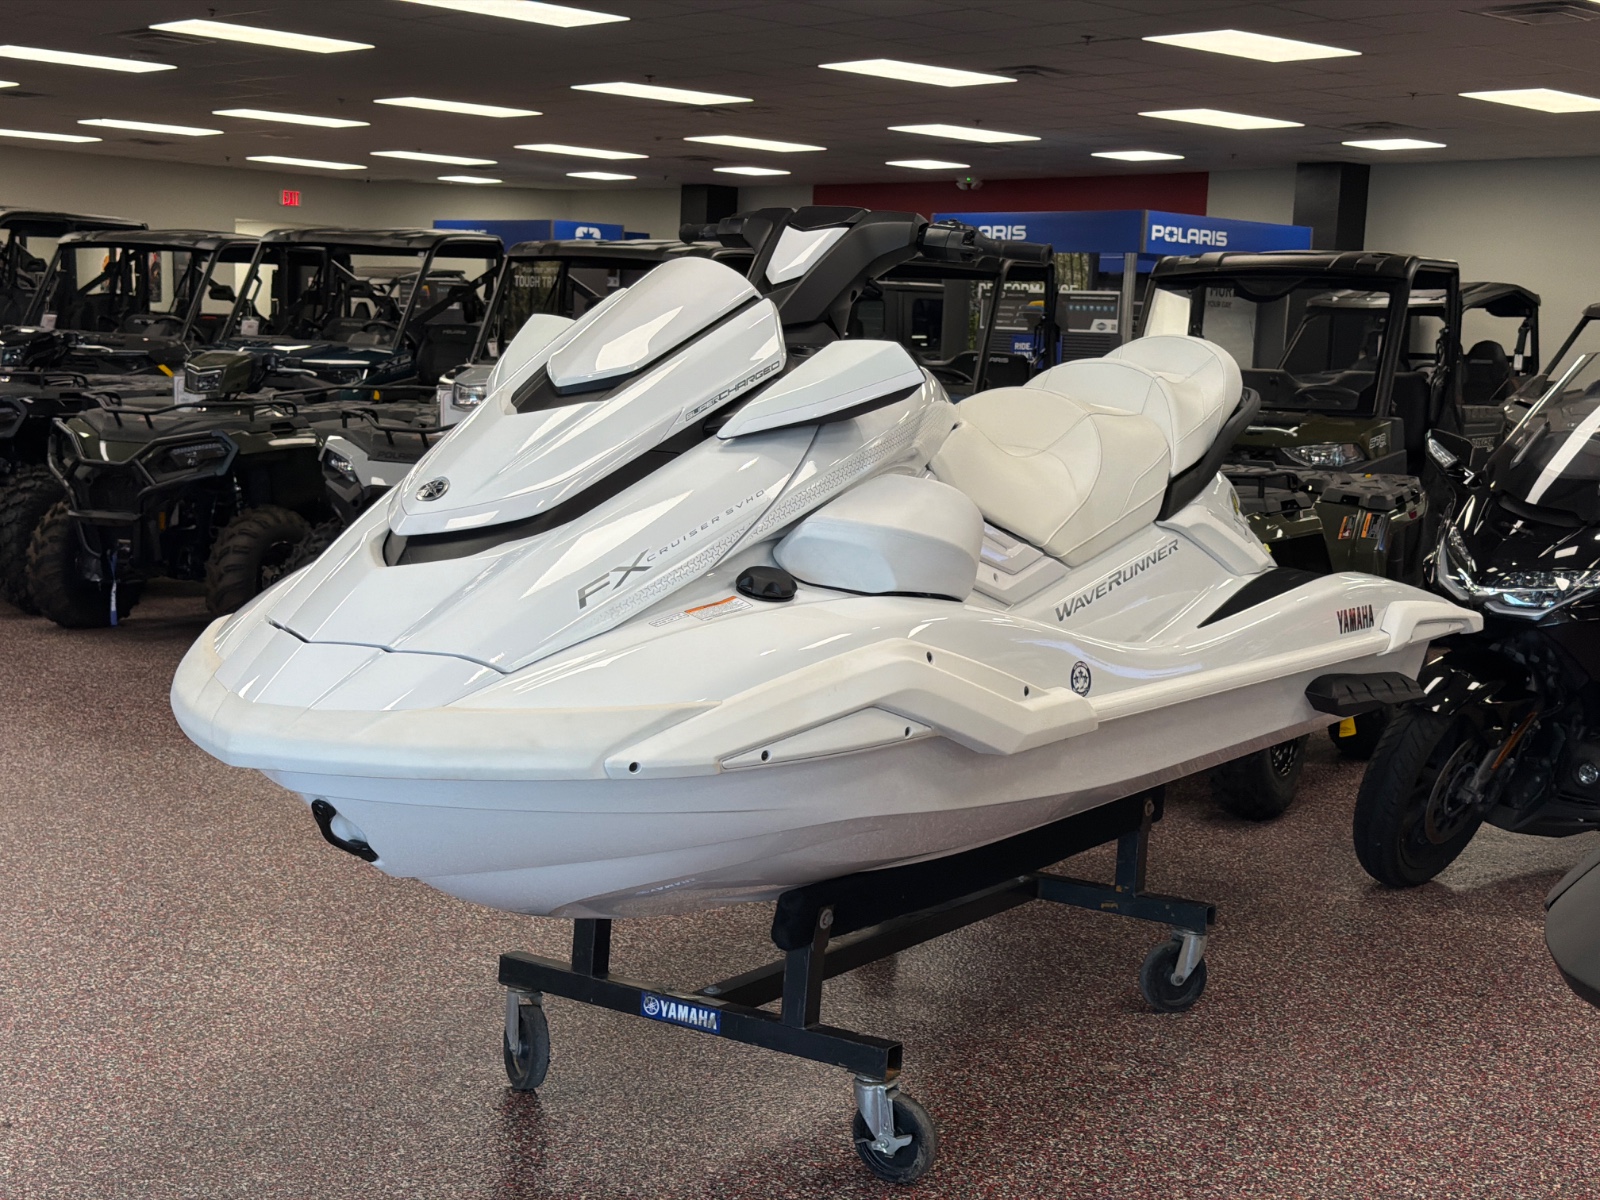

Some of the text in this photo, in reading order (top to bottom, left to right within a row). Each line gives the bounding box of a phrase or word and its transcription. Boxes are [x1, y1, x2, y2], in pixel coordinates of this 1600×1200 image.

[977, 224, 1027, 241] ARIS
[1151, 224, 1228, 247] POLARIS
[514, 275, 541, 288] TOUGH
[685, 360, 780, 422] SUPERCHARGED
[577, 548, 653, 610] FX
[646, 516, 720, 562] CRUISER
[725, 489, 765, 515] SVHO
[1336, 604, 1375, 635] YAMAHA
[660, 999, 717, 1030] YAMAHA
